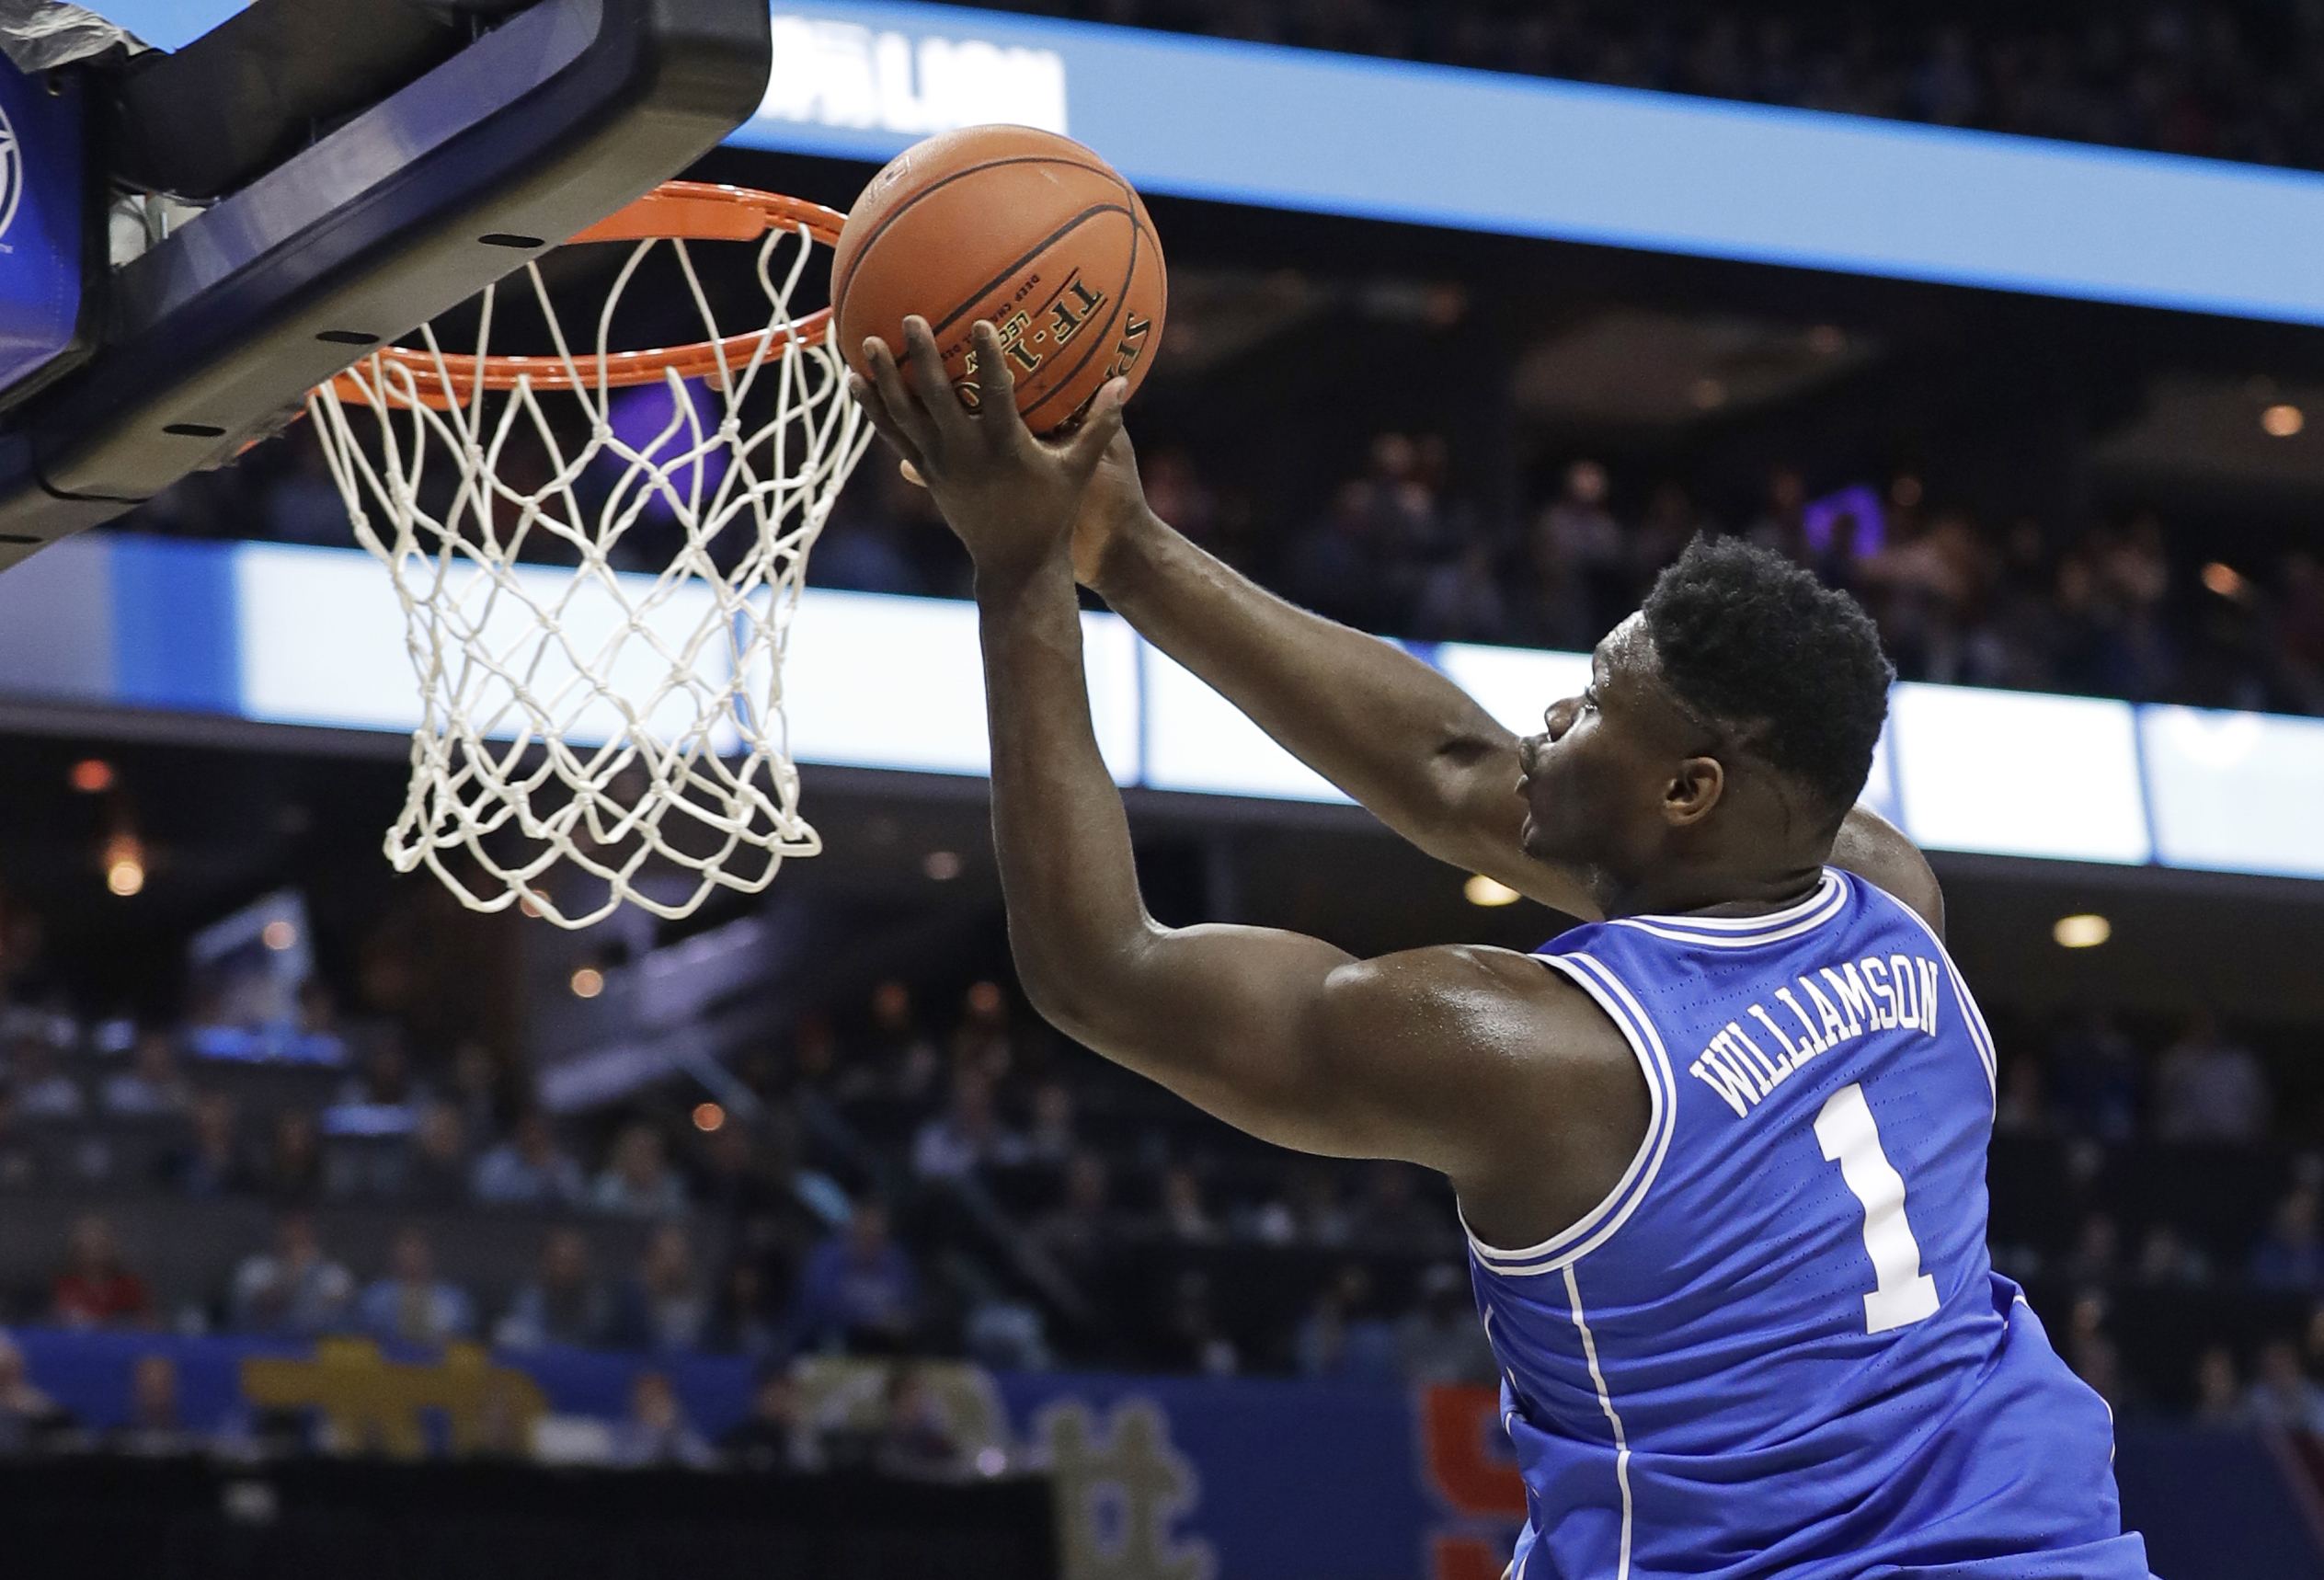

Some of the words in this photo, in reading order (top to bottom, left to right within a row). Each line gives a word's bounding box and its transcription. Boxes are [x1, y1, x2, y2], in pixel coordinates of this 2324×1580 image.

[1014, 274, 1040, 302] DEEP
[1689, 954, 1938, 1119] WILLIAMSON
[1813, 1082, 1941, 1335] 1
